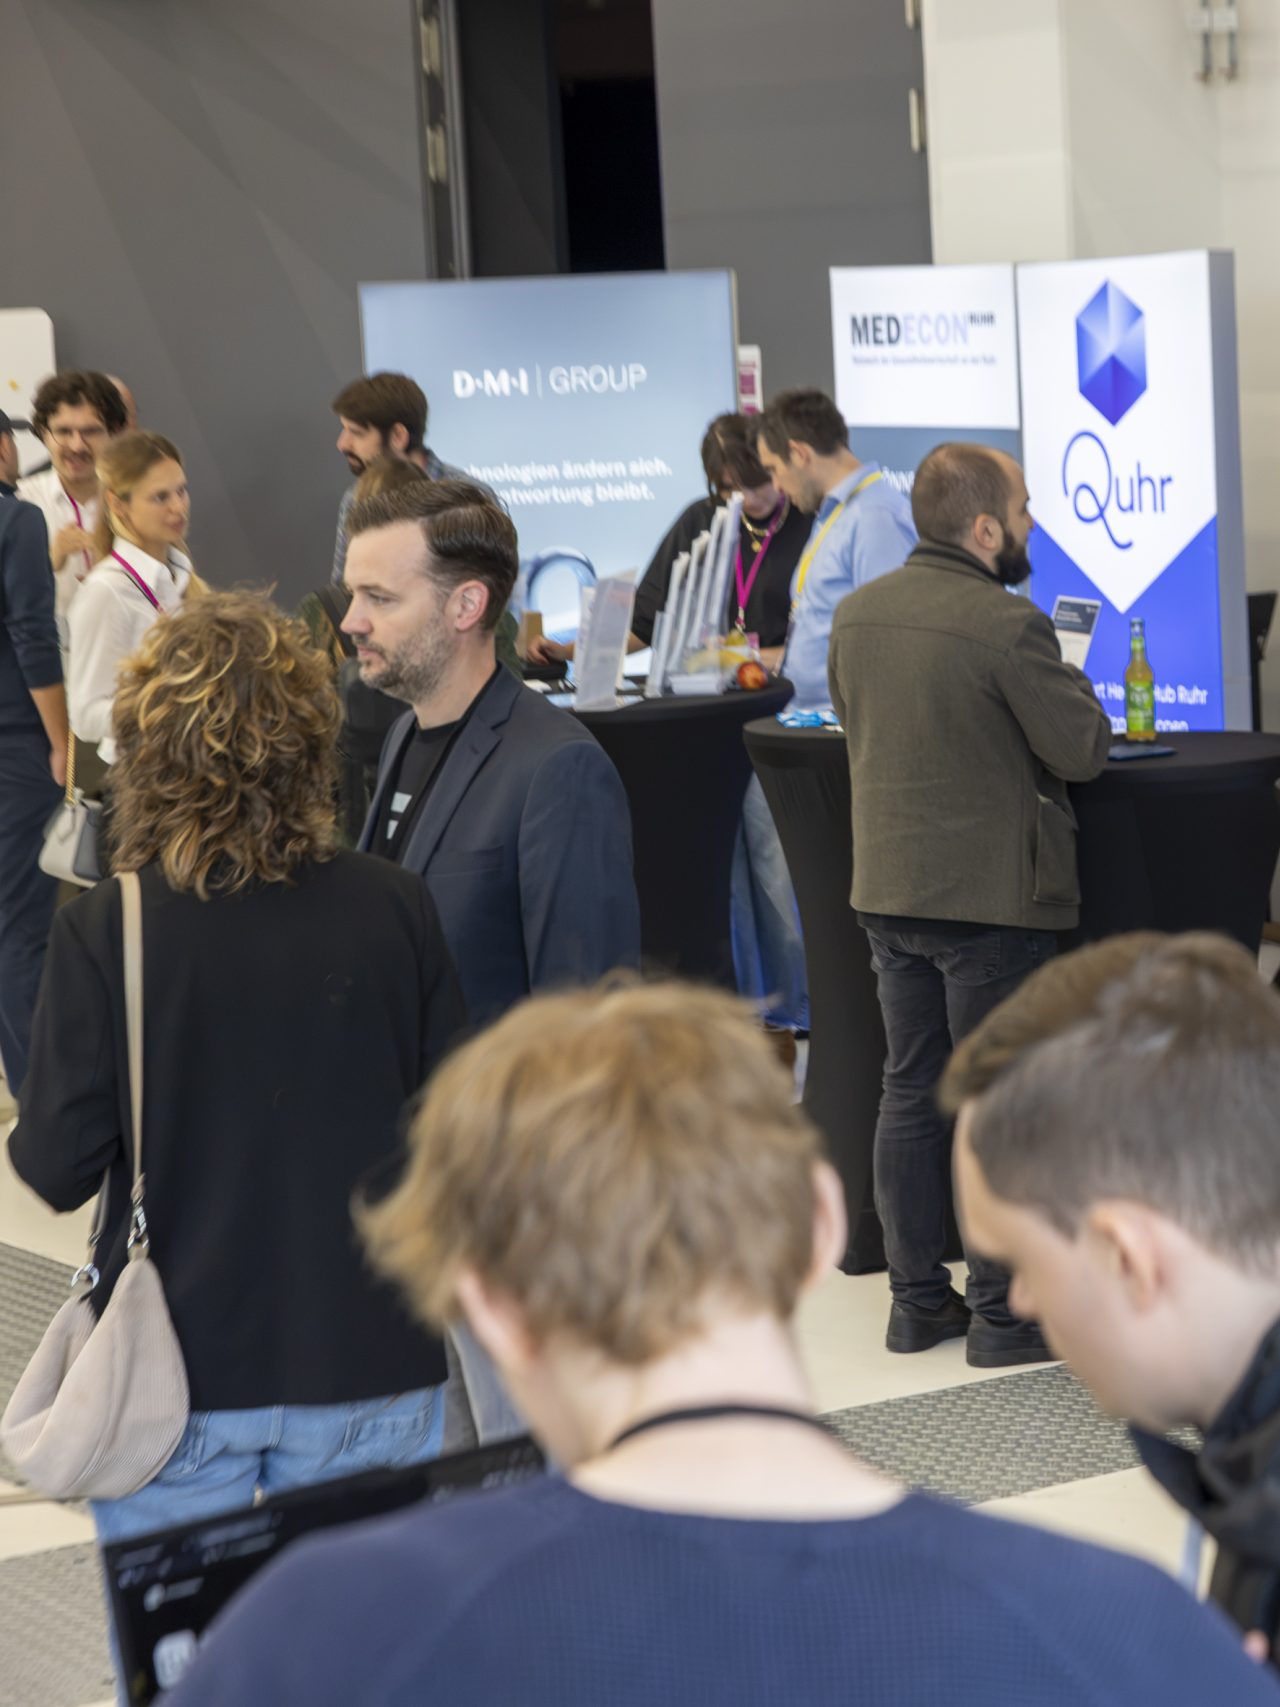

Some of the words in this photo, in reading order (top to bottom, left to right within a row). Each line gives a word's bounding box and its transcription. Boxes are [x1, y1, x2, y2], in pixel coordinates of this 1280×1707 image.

[850, 312, 968, 347] MEDECON
[549, 362, 648, 395] GROUP
[464, 461, 560, 487] hnologien
[498, 484, 595, 508] ntwortung
